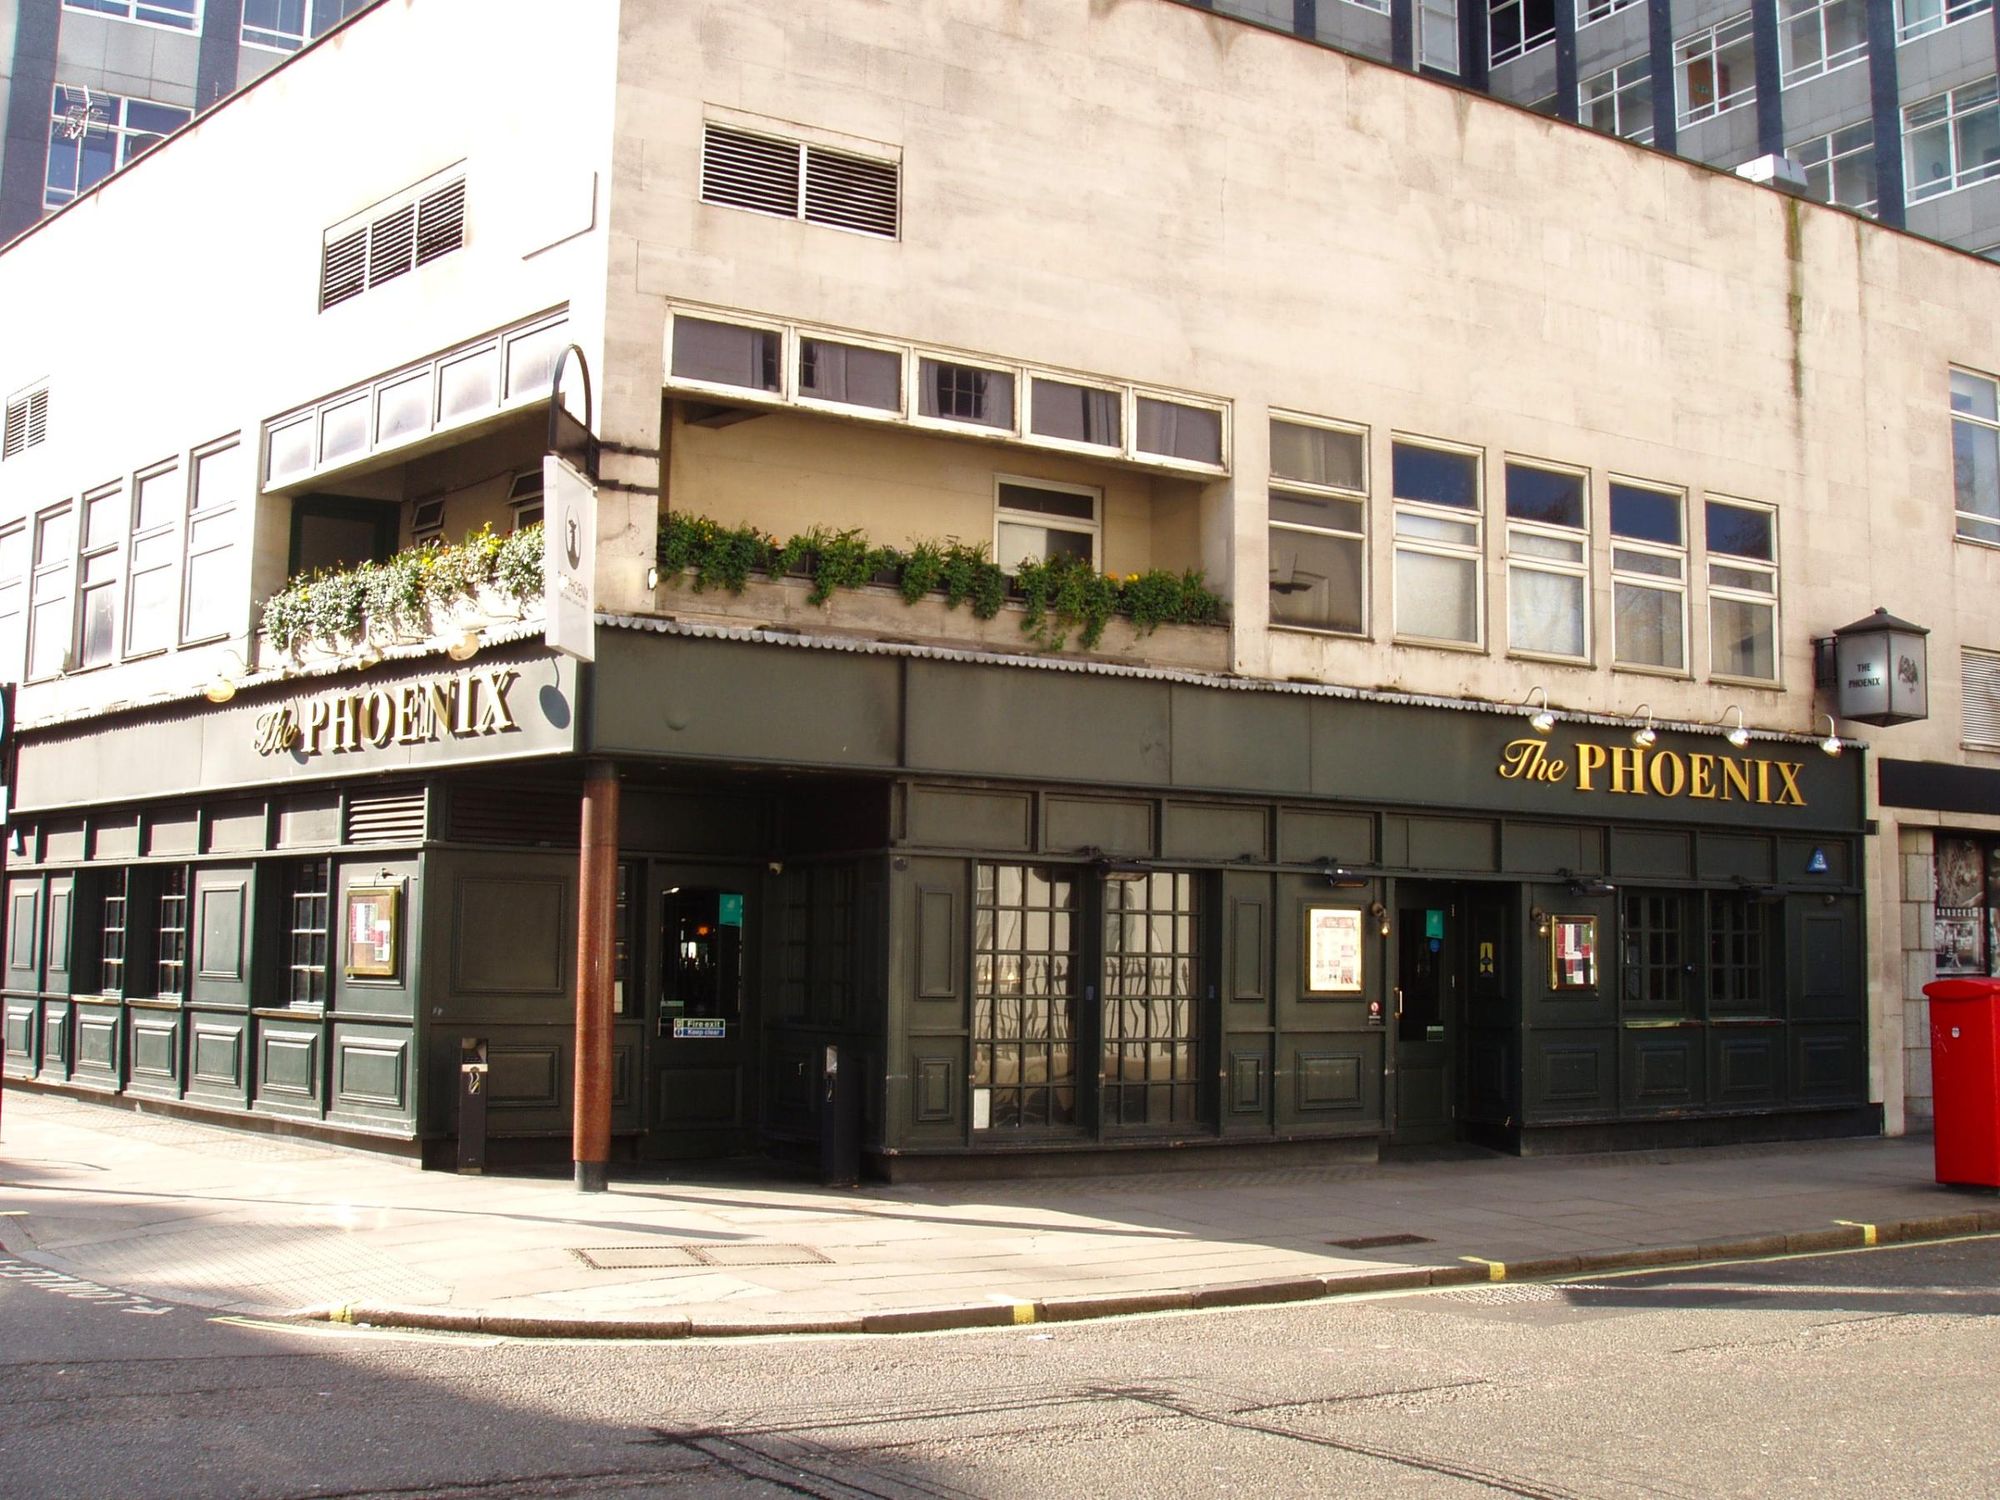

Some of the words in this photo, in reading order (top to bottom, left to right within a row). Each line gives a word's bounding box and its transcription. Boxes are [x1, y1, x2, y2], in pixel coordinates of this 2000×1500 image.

[1856, 663, 1872, 672] THE
[1848, 678, 1881, 688] PHOENIX
[253, 706, 300, 755] The
[301, 668, 519, 754] PHOENIX
[1497, 737, 1569, 783] The
[1574, 742, 1808, 807] PHOENIX
[687, 1020, 703, 1028] Fire
